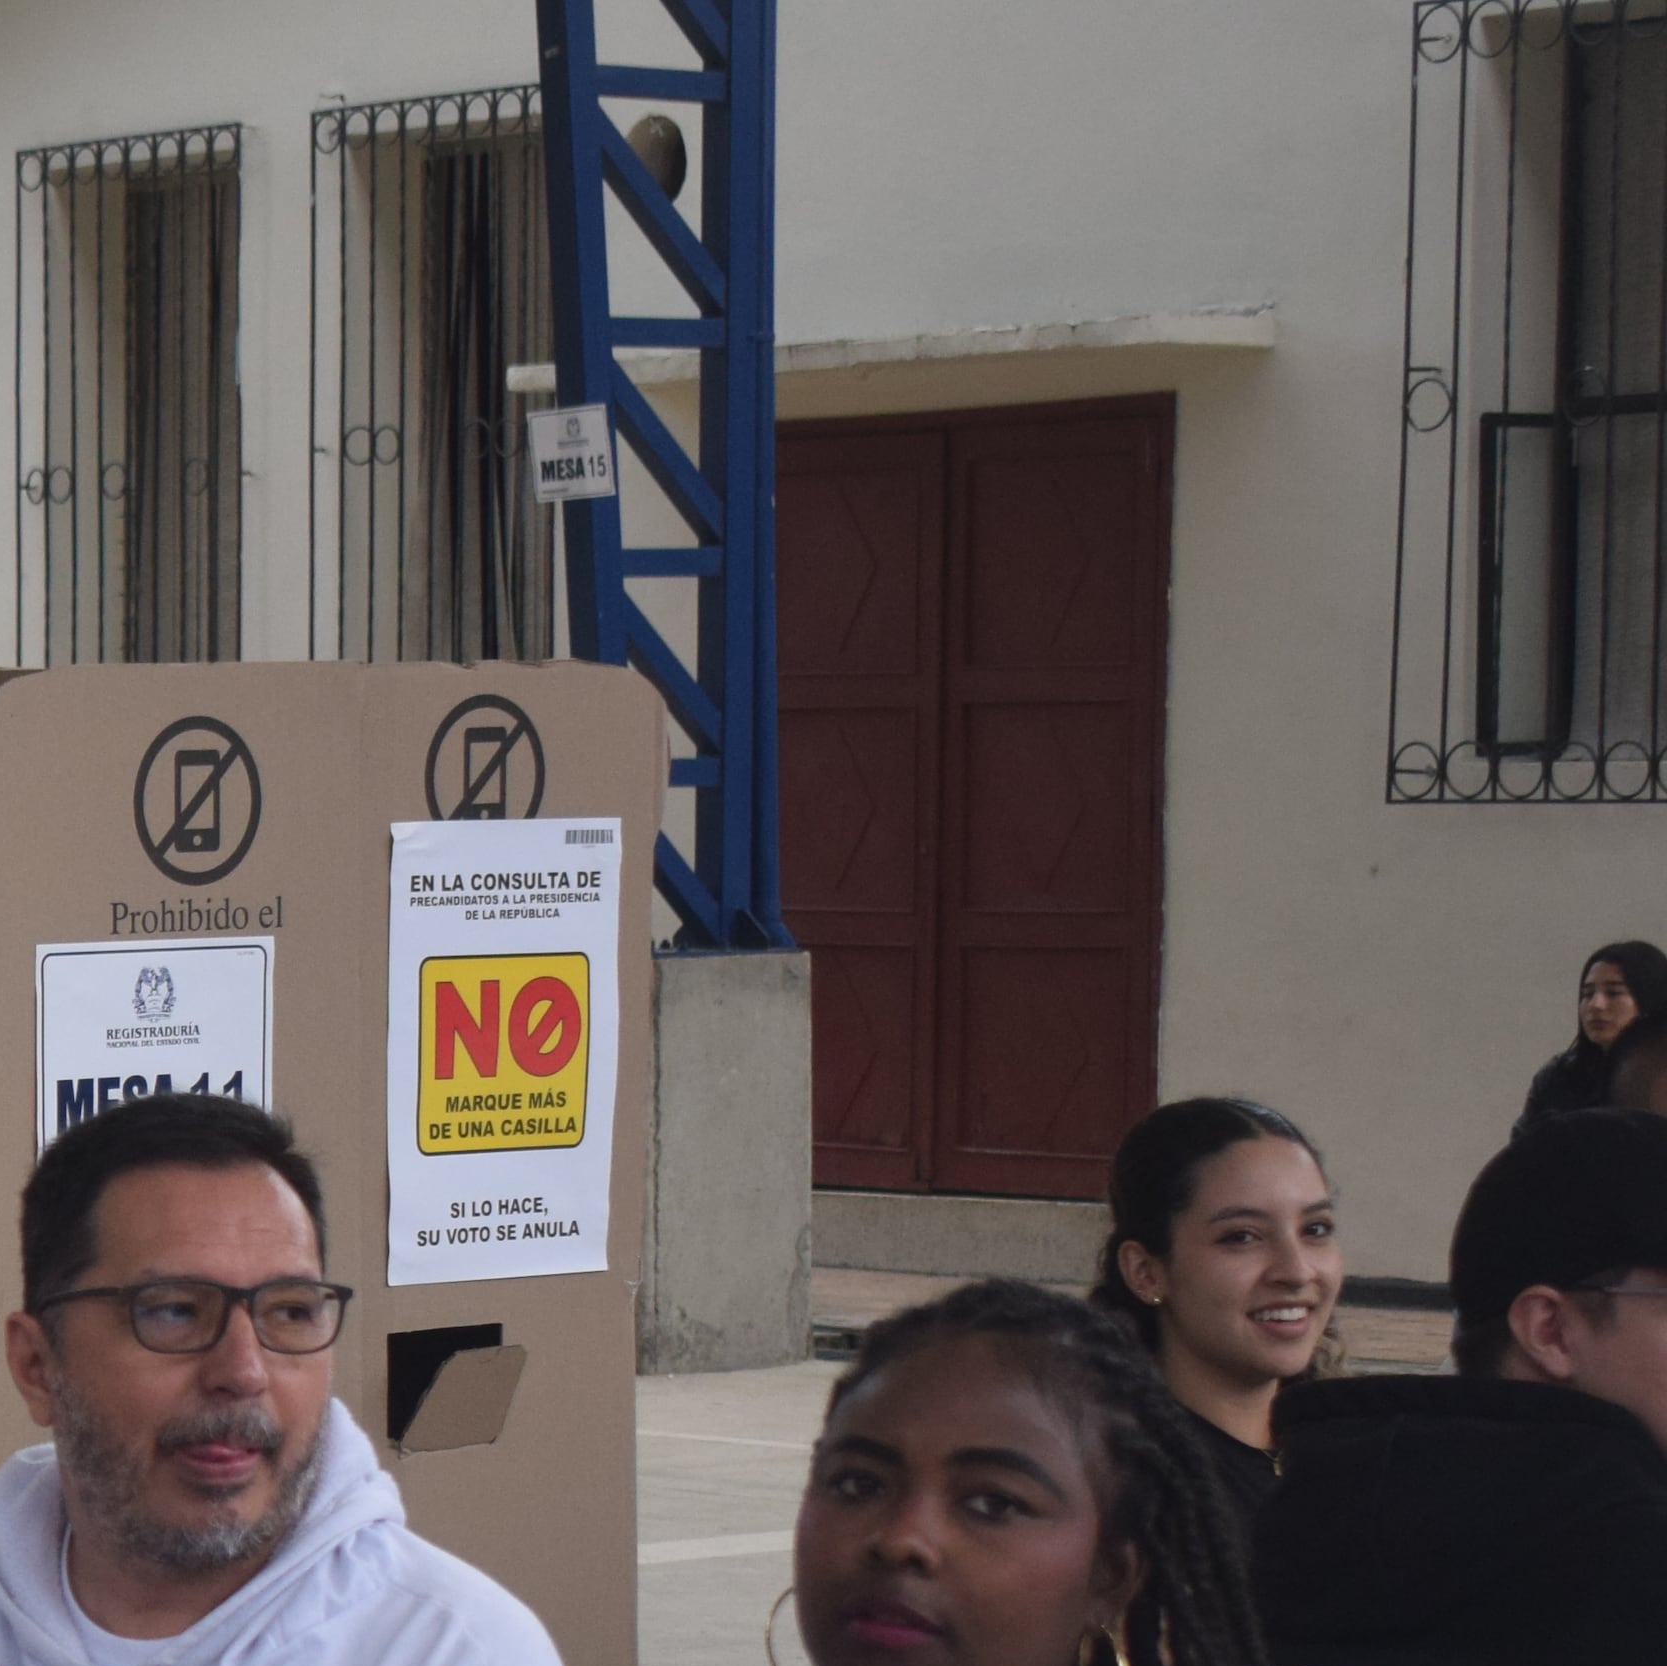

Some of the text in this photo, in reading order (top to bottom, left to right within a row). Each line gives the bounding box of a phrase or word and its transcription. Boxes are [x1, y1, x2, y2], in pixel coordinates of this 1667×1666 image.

[541, 455, 607, 483] MESA 15
[410, 871, 602, 892] EN LA CONSULTA DE
[410, 892, 601, 907] PRECANDIDATOS A LA PRESIDENCIA
[110, 896, 284, 935] Prohibido el
[465, 906, 560, 920] DE LA REPÚBLICA
[106, 1021, 201, 1040] REGISTRADURÍA
[434, 976, 582, 1080] NO
[445, 1088, 567, 1112] MARQUE MÁS
[429, 1117, 578, 1140] DE UNA CASILLA
[451, 1197, 548, 1218] SI LO HACE,
[417, 1221, 580, 1247] SU VOTO SE ANULA
